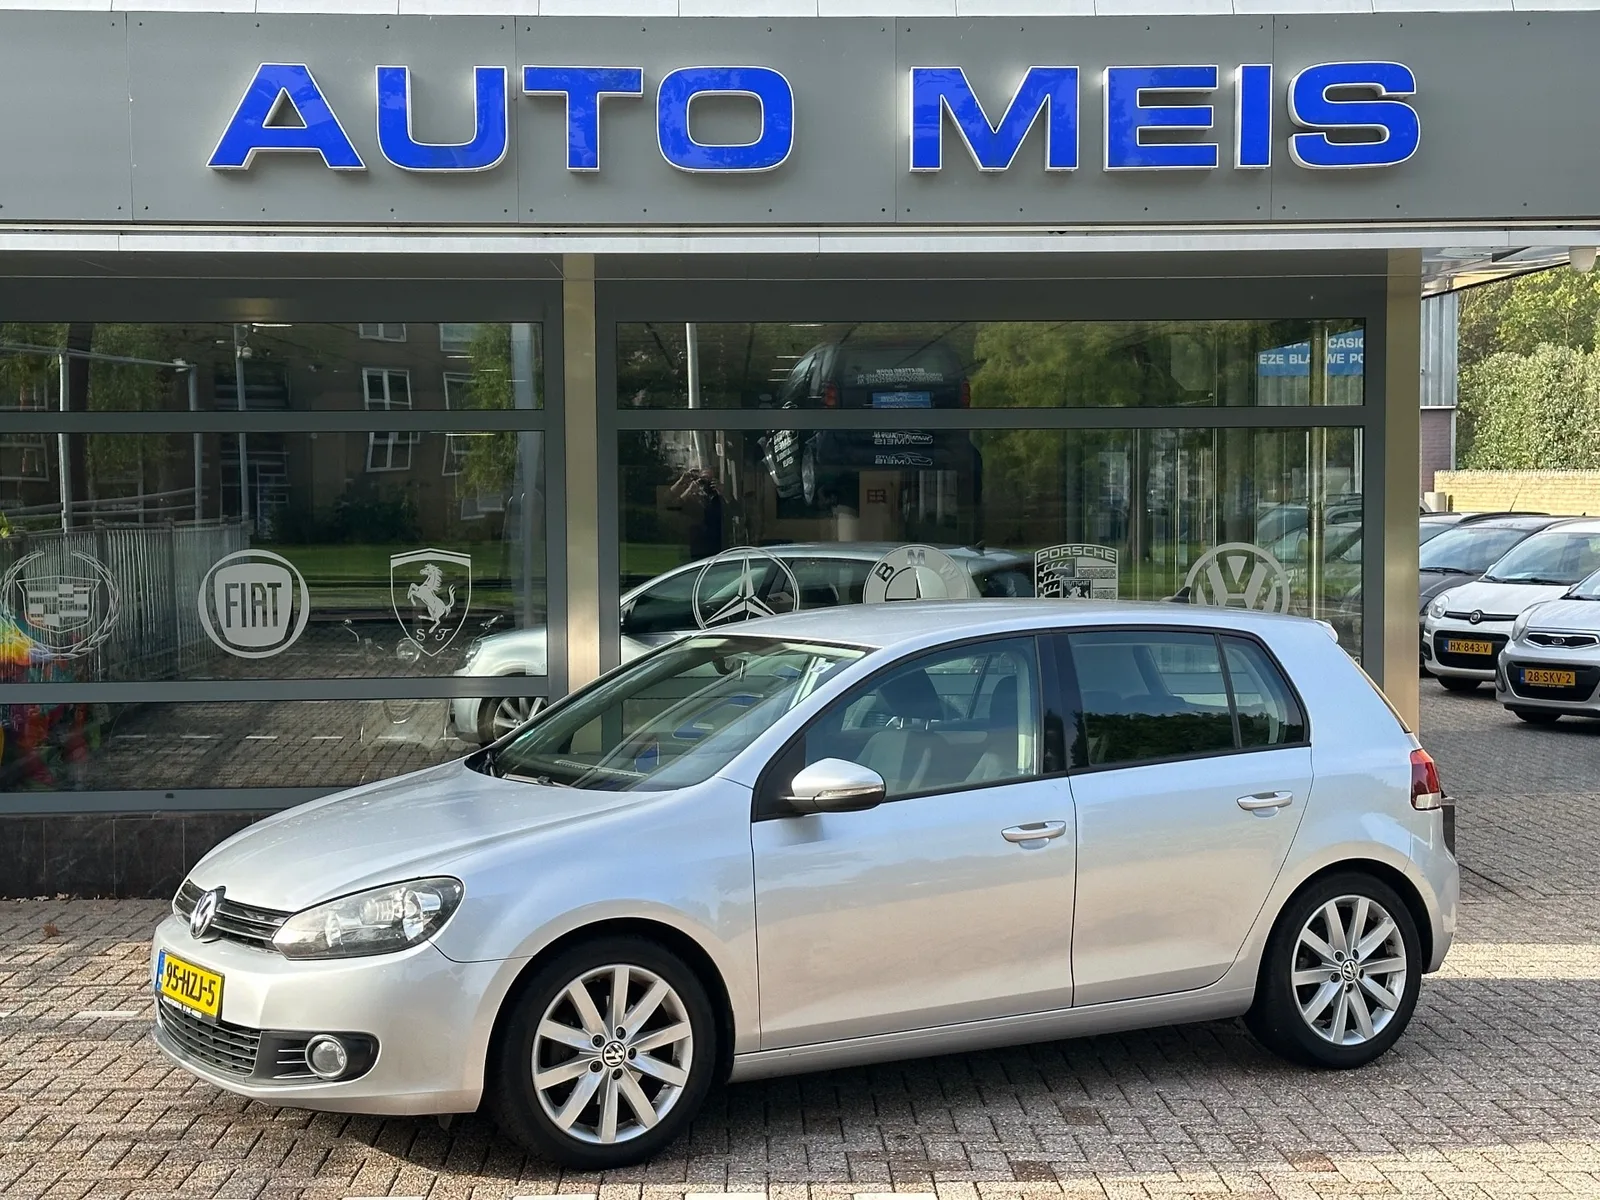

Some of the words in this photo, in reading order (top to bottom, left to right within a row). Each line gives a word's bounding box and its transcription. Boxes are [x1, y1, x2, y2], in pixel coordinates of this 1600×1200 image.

[205, 62, 796, 173] AUTO
[908, 61, 1421, 172] MEIS
[1037, 546, 1117, 564] PORSCHE
[224, 582, 282, 629] FIAT
[1450, 640, 1490, 653] HX-843-V
[1527, 670, 1573, 684] 28-SKV-2
[165, 961, 217, 1007] 95-HZJ-5
